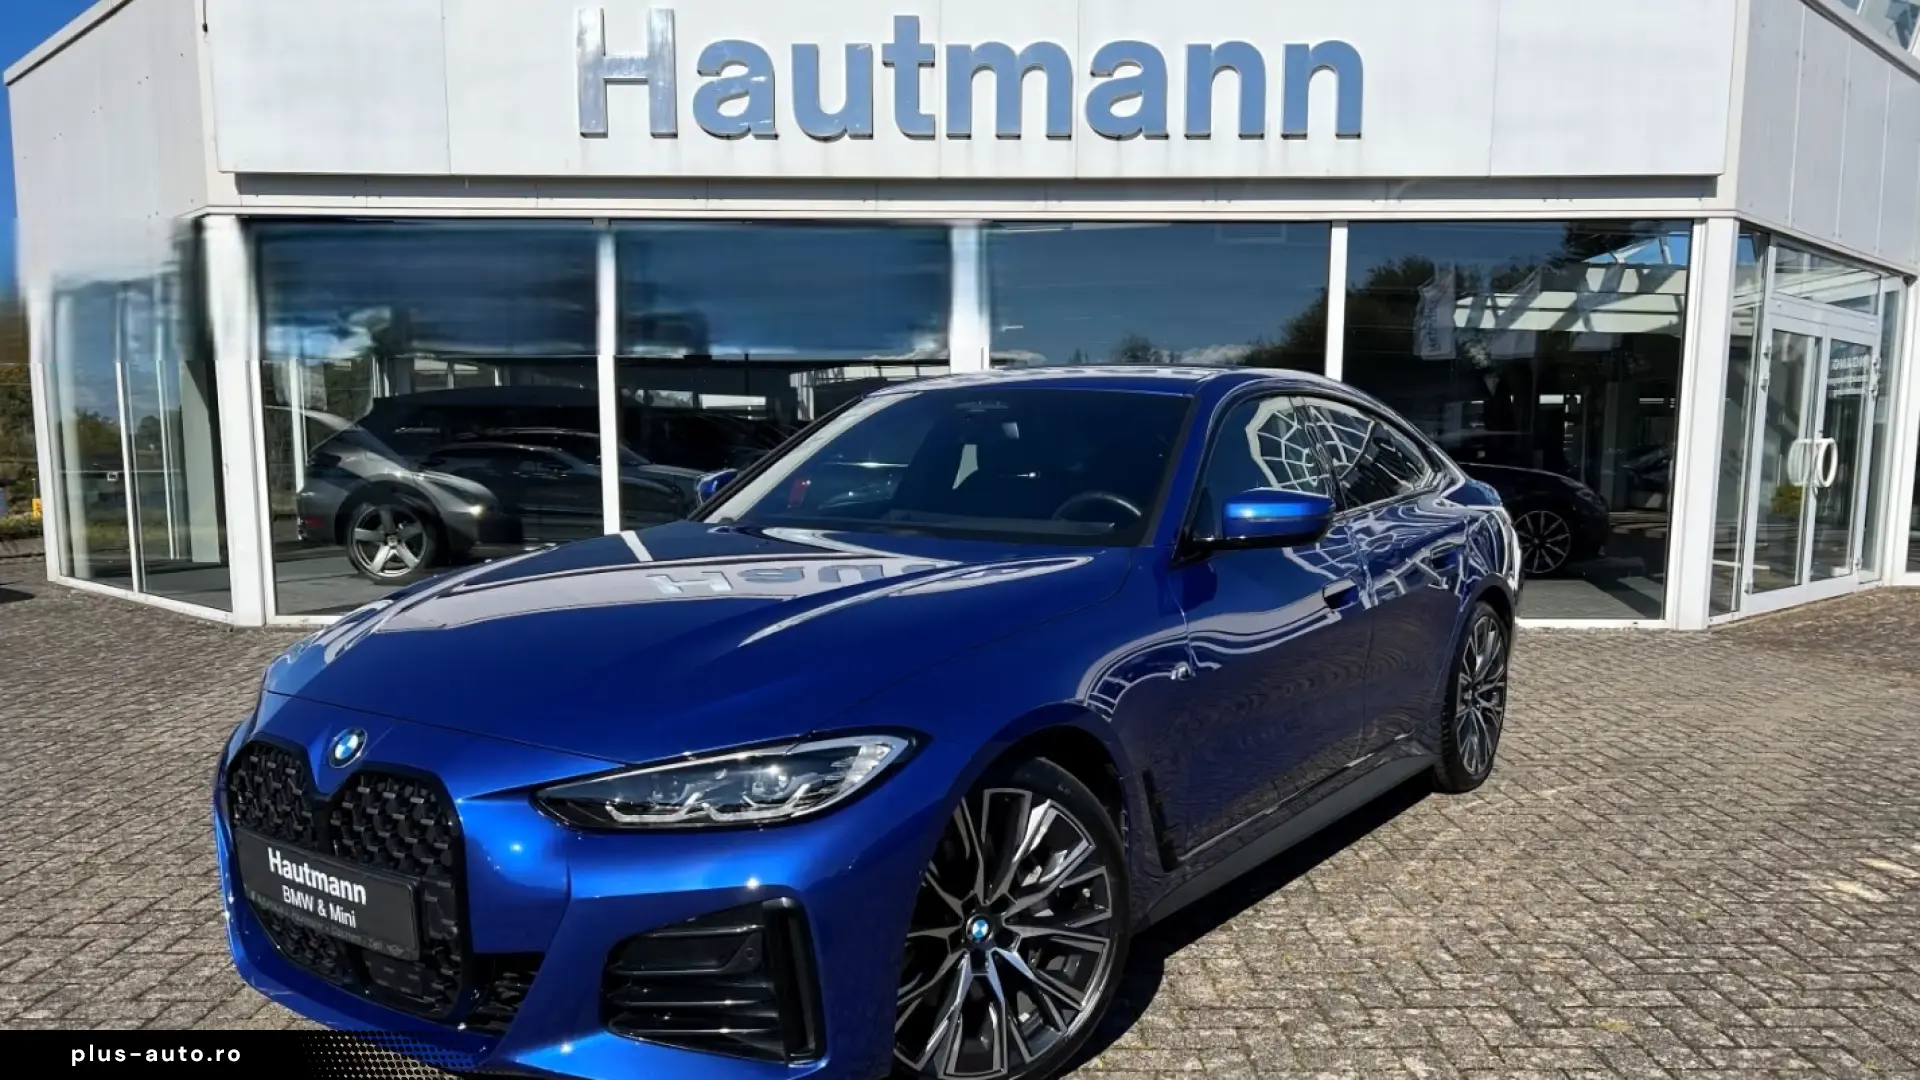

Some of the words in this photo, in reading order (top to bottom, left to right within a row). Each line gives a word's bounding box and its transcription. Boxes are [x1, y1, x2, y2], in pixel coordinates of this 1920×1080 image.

[576, 8, 1363, 141] Hautmann
[268, 847, 367, 906] Hautmann
[282, 884, 314, 913] BMW
[317, 898, 328, 918] &
[329, 902, 356, 929] Mini
